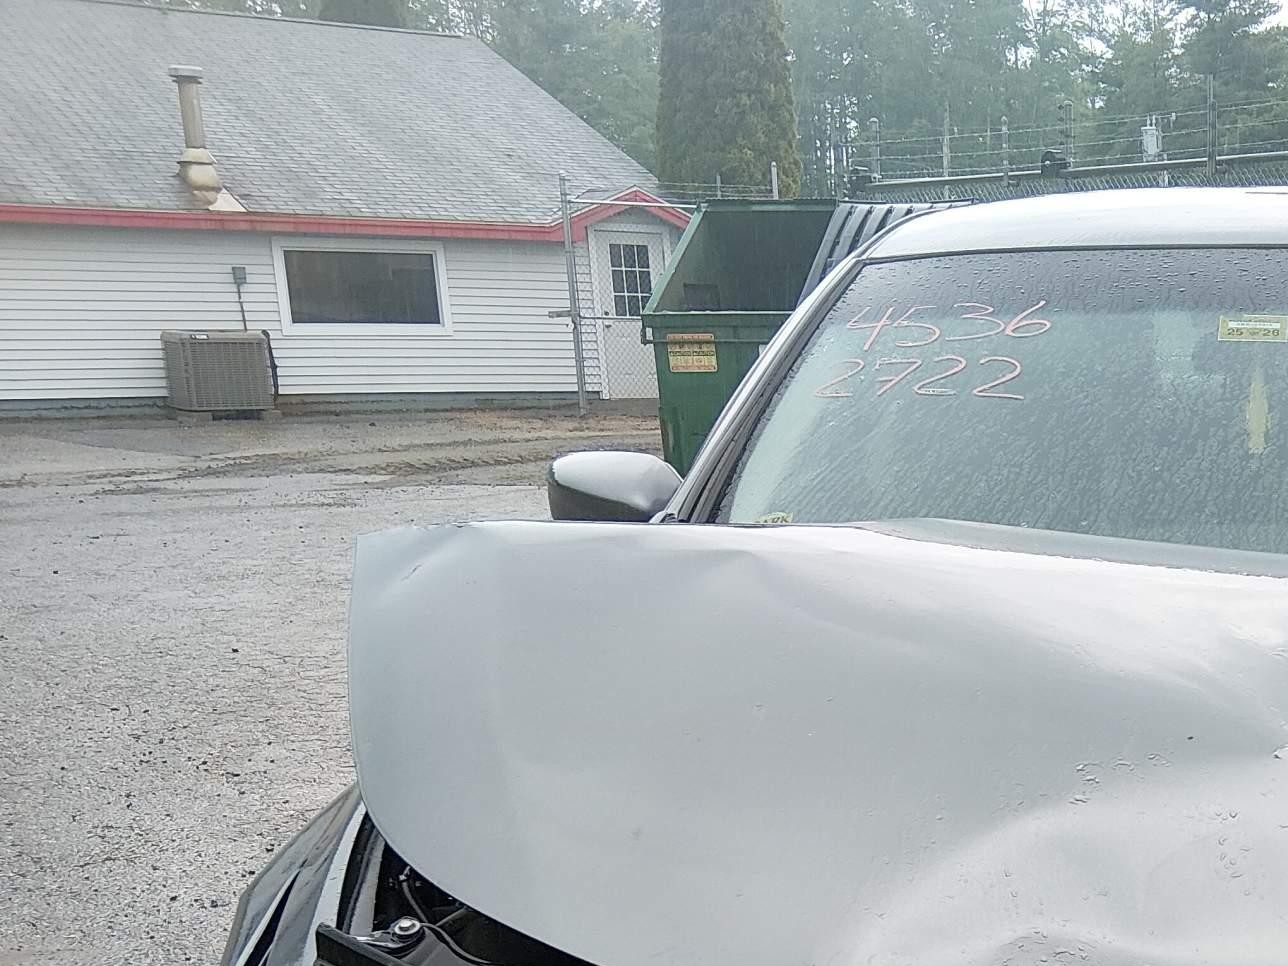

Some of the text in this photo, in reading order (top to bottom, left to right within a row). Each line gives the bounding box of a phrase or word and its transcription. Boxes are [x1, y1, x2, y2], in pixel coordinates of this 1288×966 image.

[846, 300, 1052, 351] 4536
[1227, 328, 1243, 336] 25
[815, 355, 1024, 400] 2722
